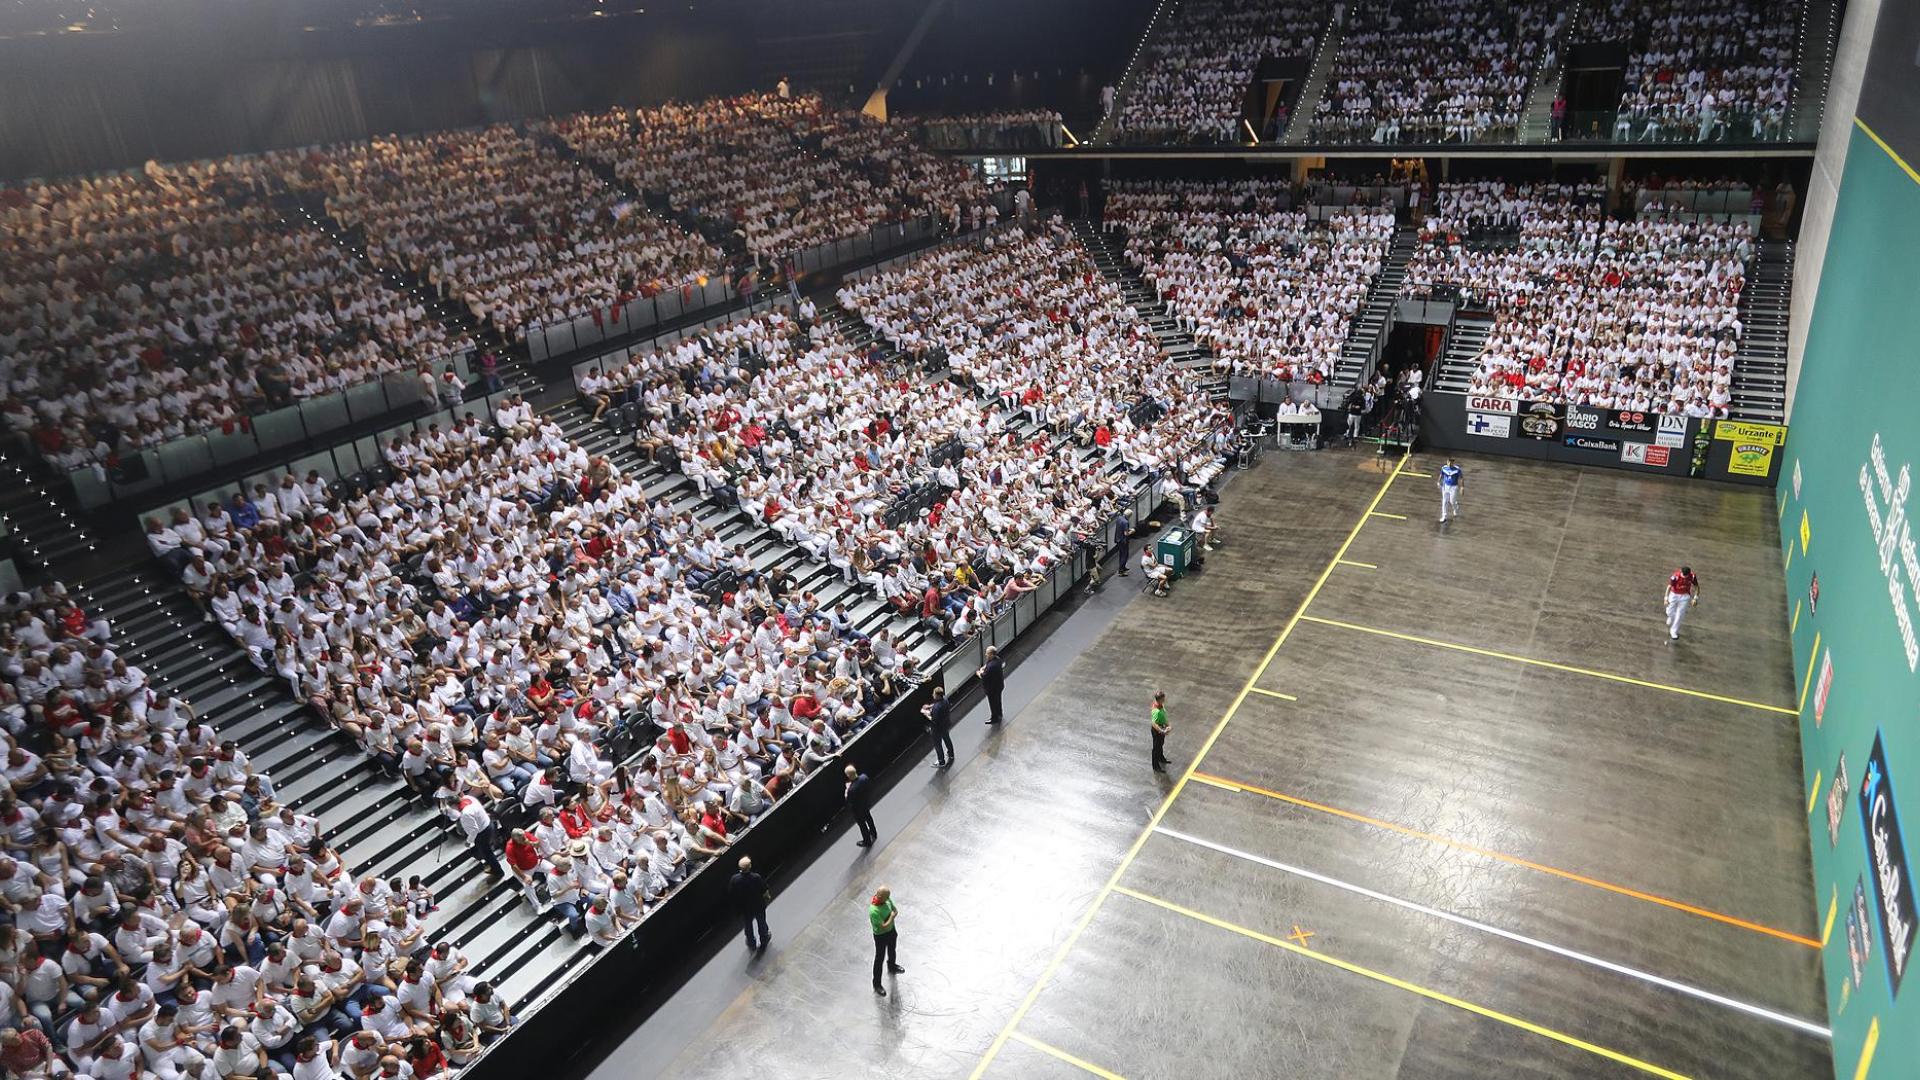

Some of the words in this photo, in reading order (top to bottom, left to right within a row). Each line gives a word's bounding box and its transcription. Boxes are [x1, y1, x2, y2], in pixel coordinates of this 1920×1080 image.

[1471, 398, 1512, 412] GARA
[1568, 405, 1579, 414] EL
[1566, 413, 1599, 423] DIARIO
[1660, 415, 1685, 430] DN
[1566, 420, 1597, 430] VASCO
[1738, 428, 1774, 439] Urzante
[1576, 439, 1618, 451] CaixaBank
[1737, 445, 1768, 455] URZANTE
[1872, 793, 1910, 977] CaixaBank
